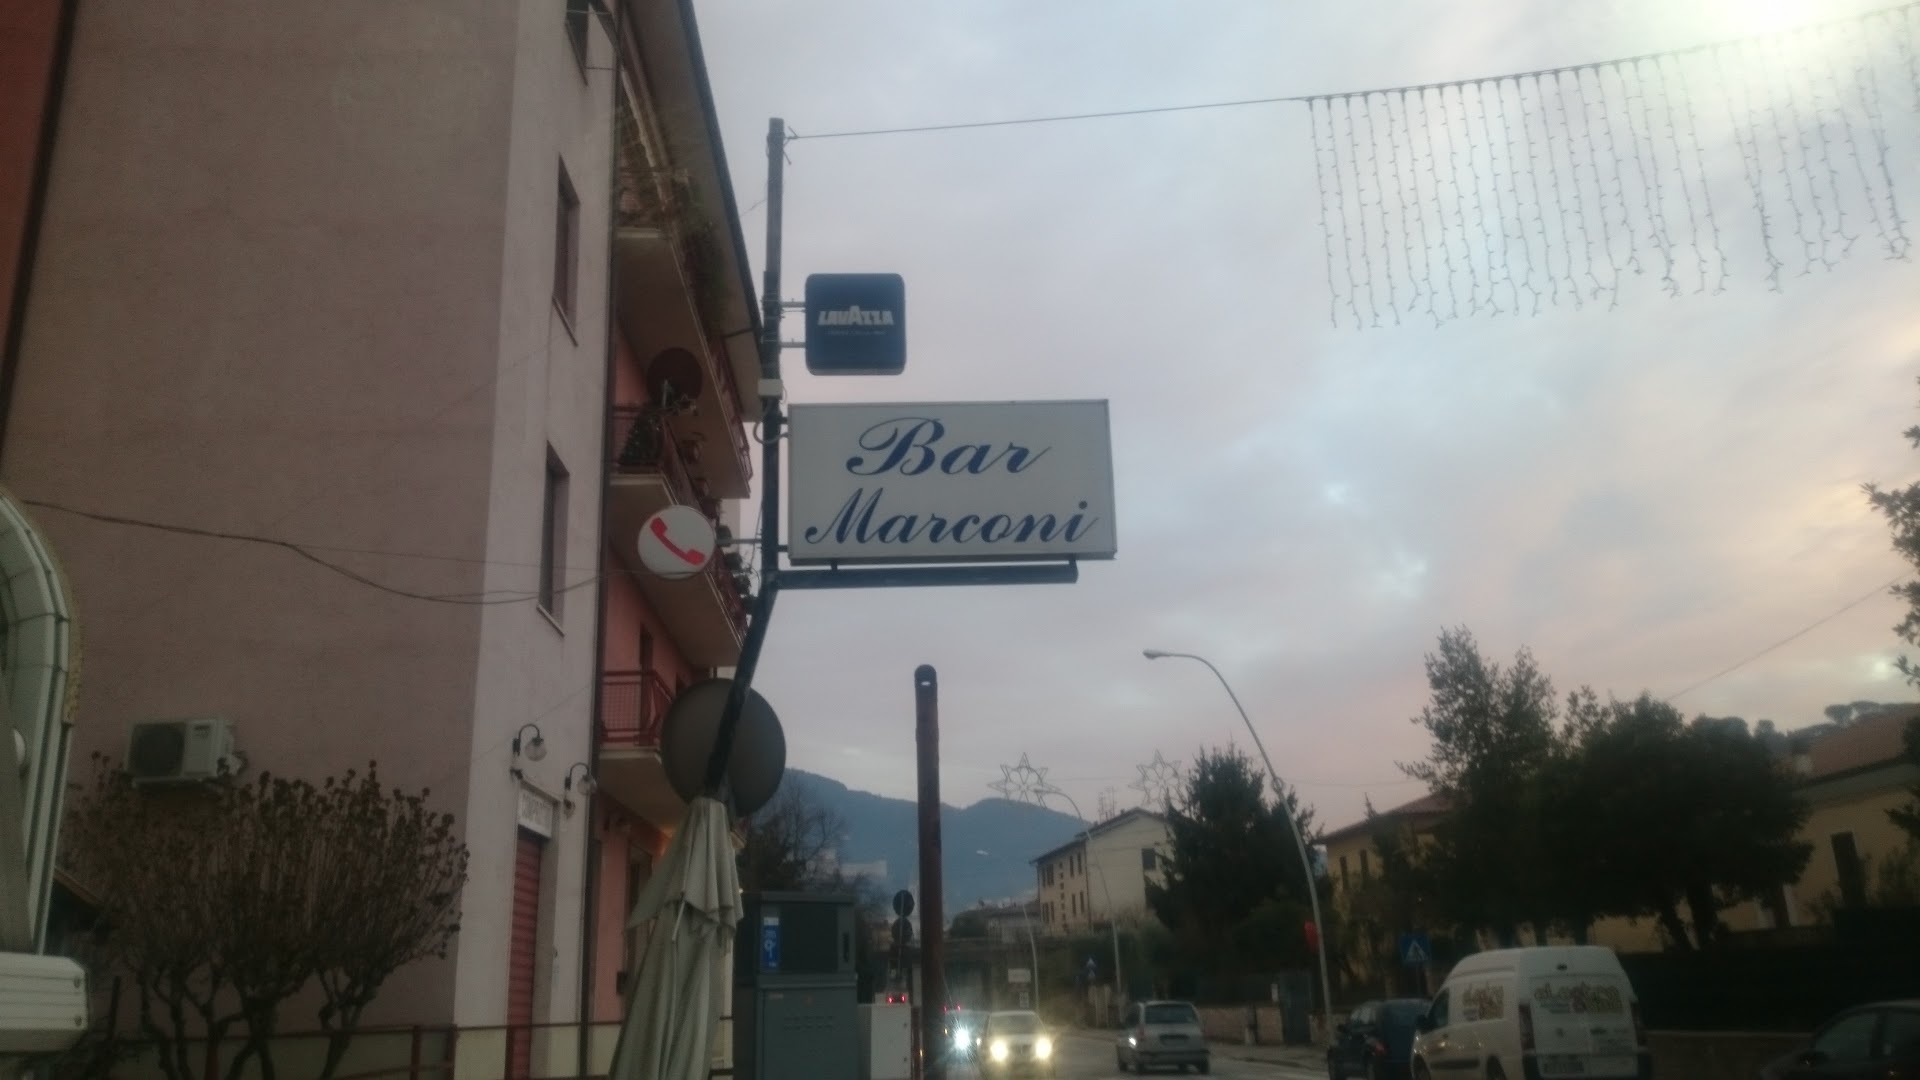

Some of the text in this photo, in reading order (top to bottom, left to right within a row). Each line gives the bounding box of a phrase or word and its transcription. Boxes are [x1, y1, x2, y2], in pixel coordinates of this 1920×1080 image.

[818, 305, 894, 326] LAVAZZA
[846, 417, 1053, 476] Bar
[805, 487, 1099, 545] Marconi
